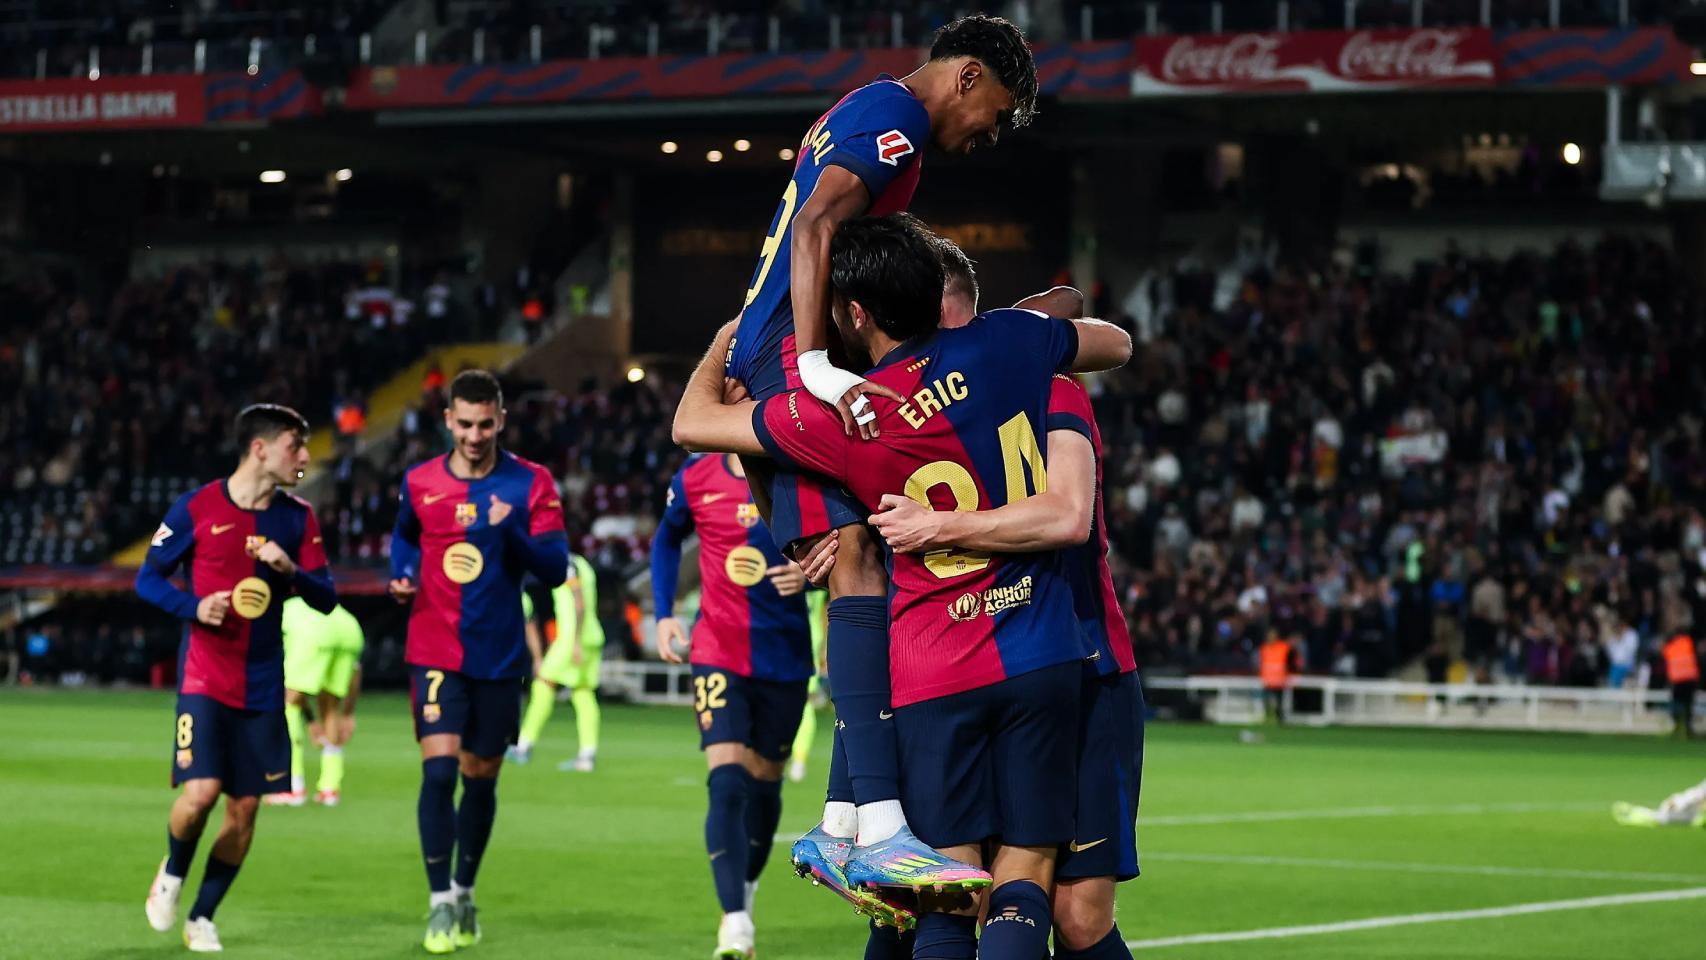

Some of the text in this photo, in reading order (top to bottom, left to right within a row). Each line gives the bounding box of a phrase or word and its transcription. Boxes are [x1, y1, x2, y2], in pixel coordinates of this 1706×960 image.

[897, 371, 969, 430] ERIC
[425, 670, 445, 704] 7
[694, 672, 728, 712] 32
[177, 712, 194, 749] 8
